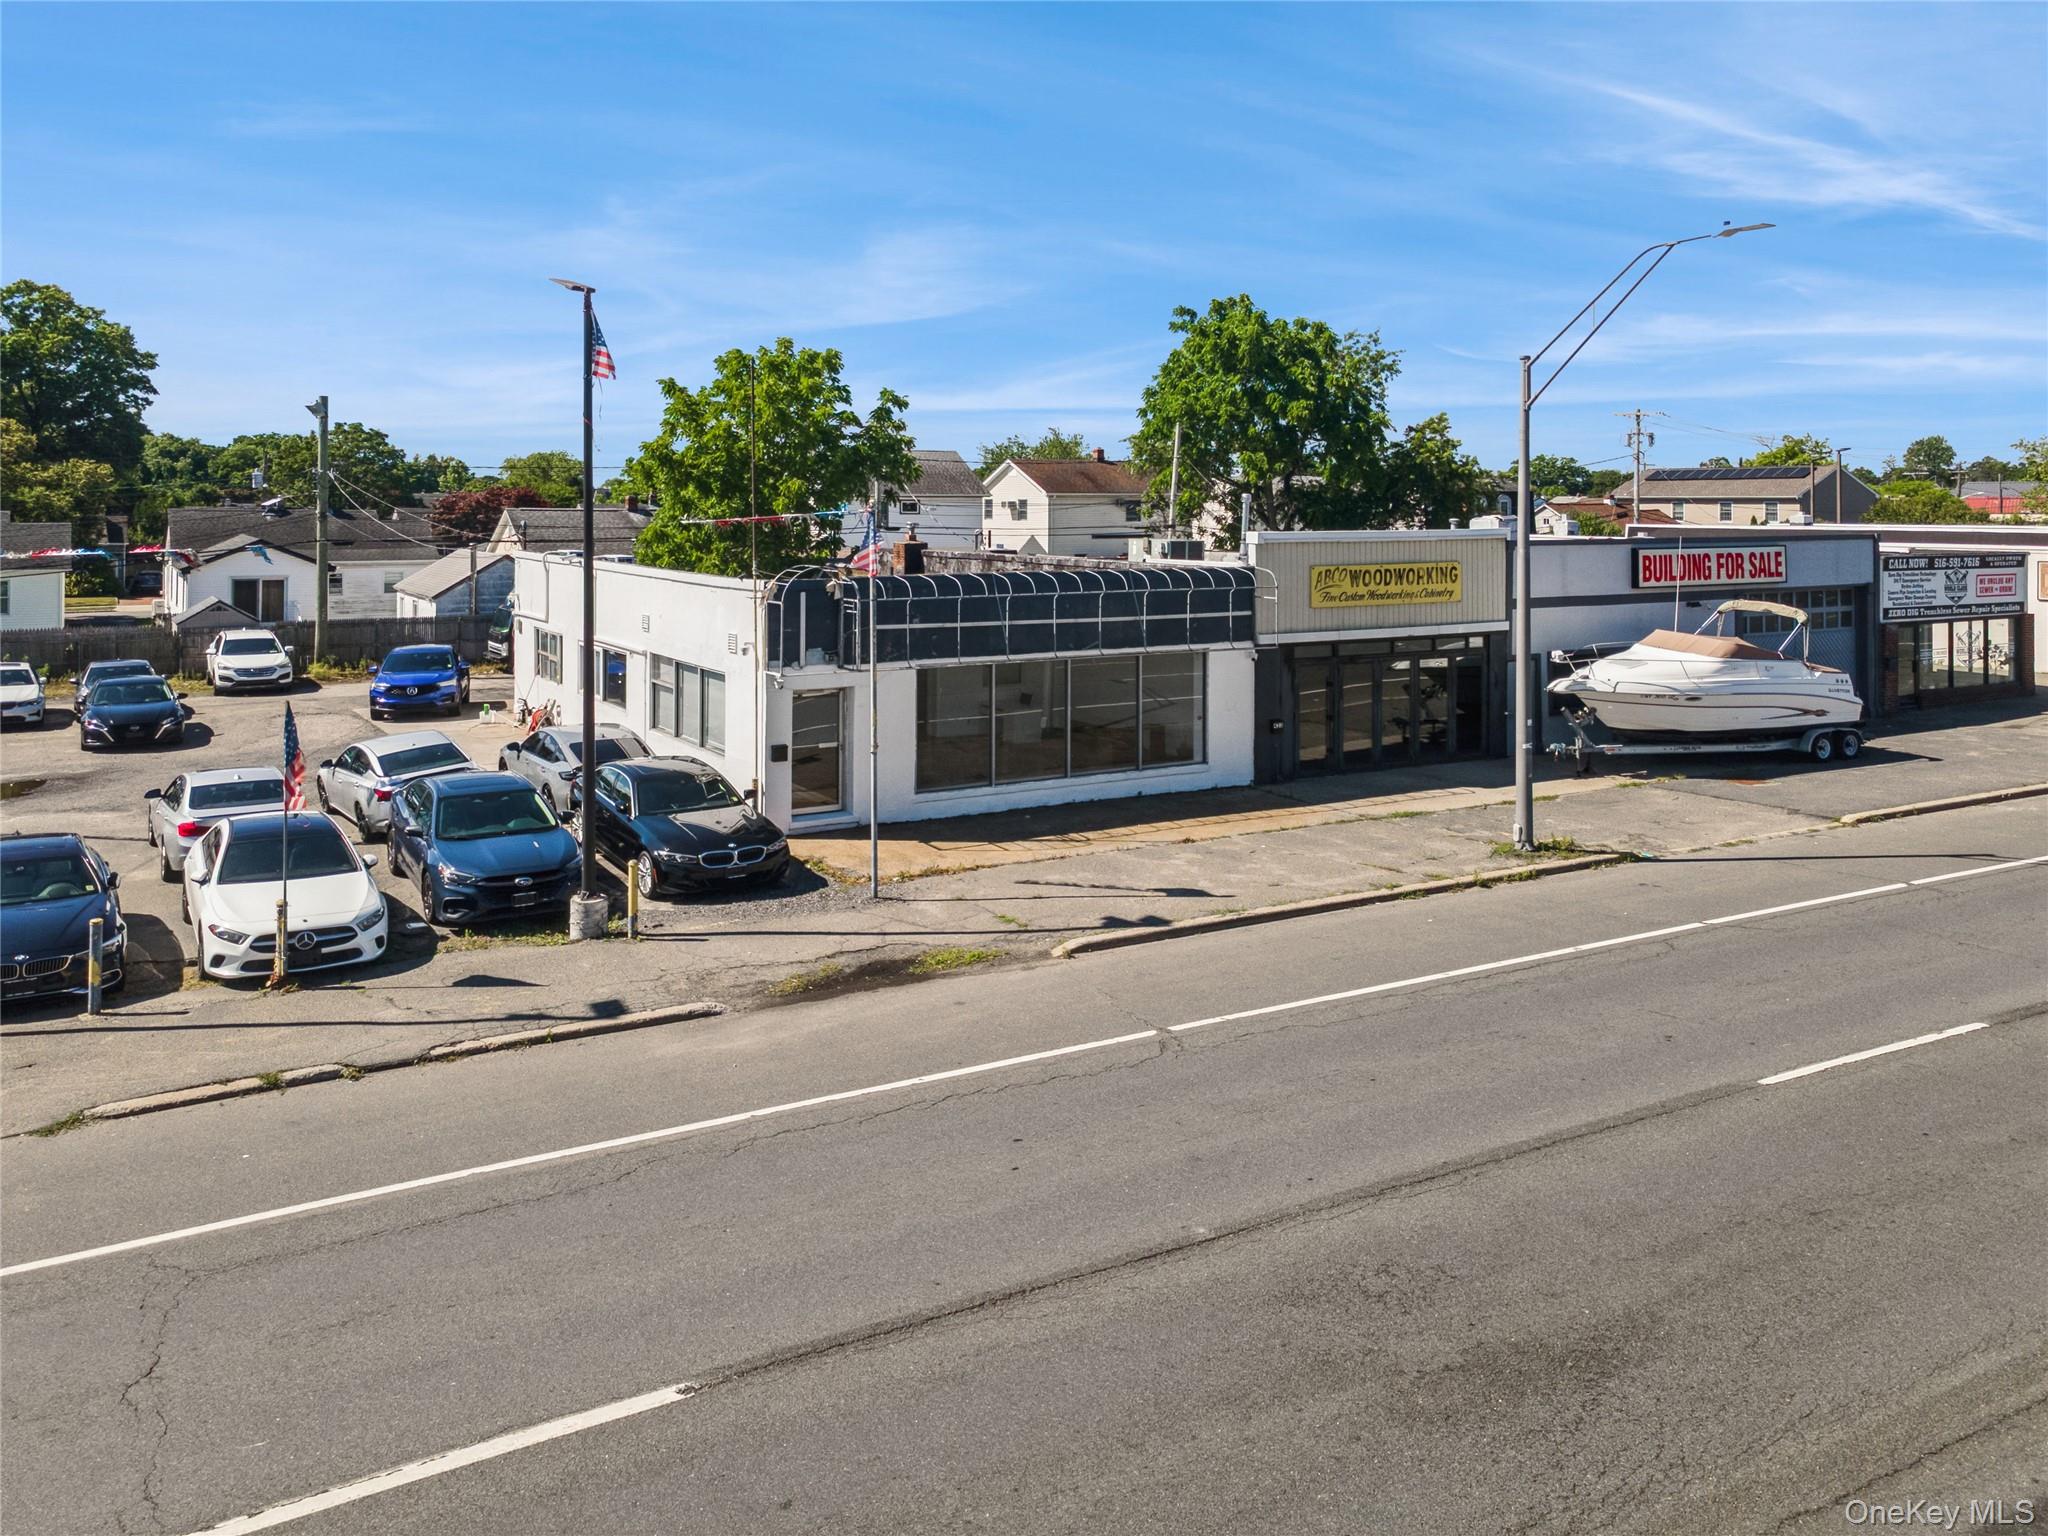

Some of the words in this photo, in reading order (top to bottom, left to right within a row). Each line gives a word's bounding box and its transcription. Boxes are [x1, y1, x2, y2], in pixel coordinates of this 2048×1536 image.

[1642, 553, 1712, 582] BUILDING
[1716, 552, 1745, 580] FOR
[1749, 551, 1783, 579] SALE
[1888, 558, 1908, 570] CALL
[1908, 558, 1929, 569] NOW!
[1314, 566, 1348, 590] ABCO
[1349, 565, 1459, 588] WOODWORKING
[1319, 591, 1339, 603] Fine
[1338, 591, 1366, 602] Custom
[1366, 589, 1415, 601] Woodworking
[1952, 606, 1970, 614] Sewer
